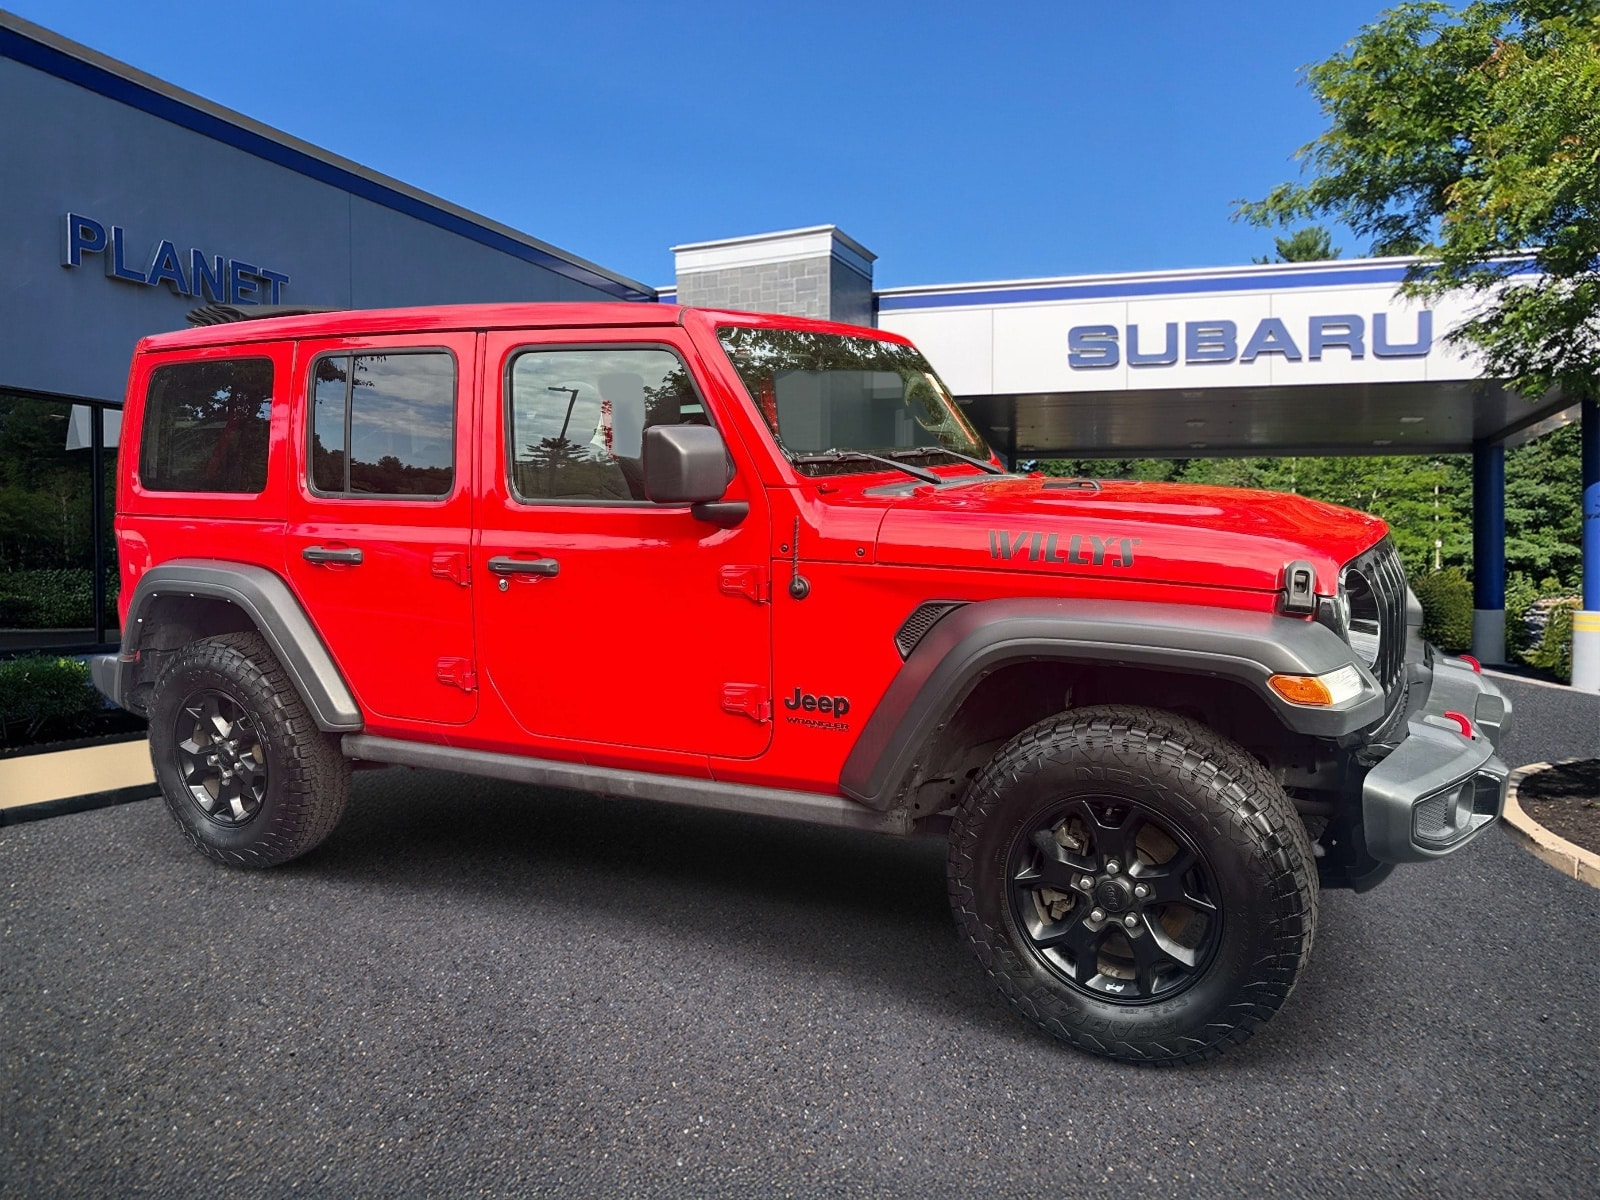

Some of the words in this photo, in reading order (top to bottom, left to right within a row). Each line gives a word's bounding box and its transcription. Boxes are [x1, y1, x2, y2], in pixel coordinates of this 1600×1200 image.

[64, 212, 291, 305] PLANET
[1067, 310, 1433, 368] SUBARU
[988, 529, 1141, 567] WILLYS
[784, 687, 850, 718] Jeep
[786, 716, 849, 730] WRANGLER
[1074, 766, 1222, 842] NEXEN
